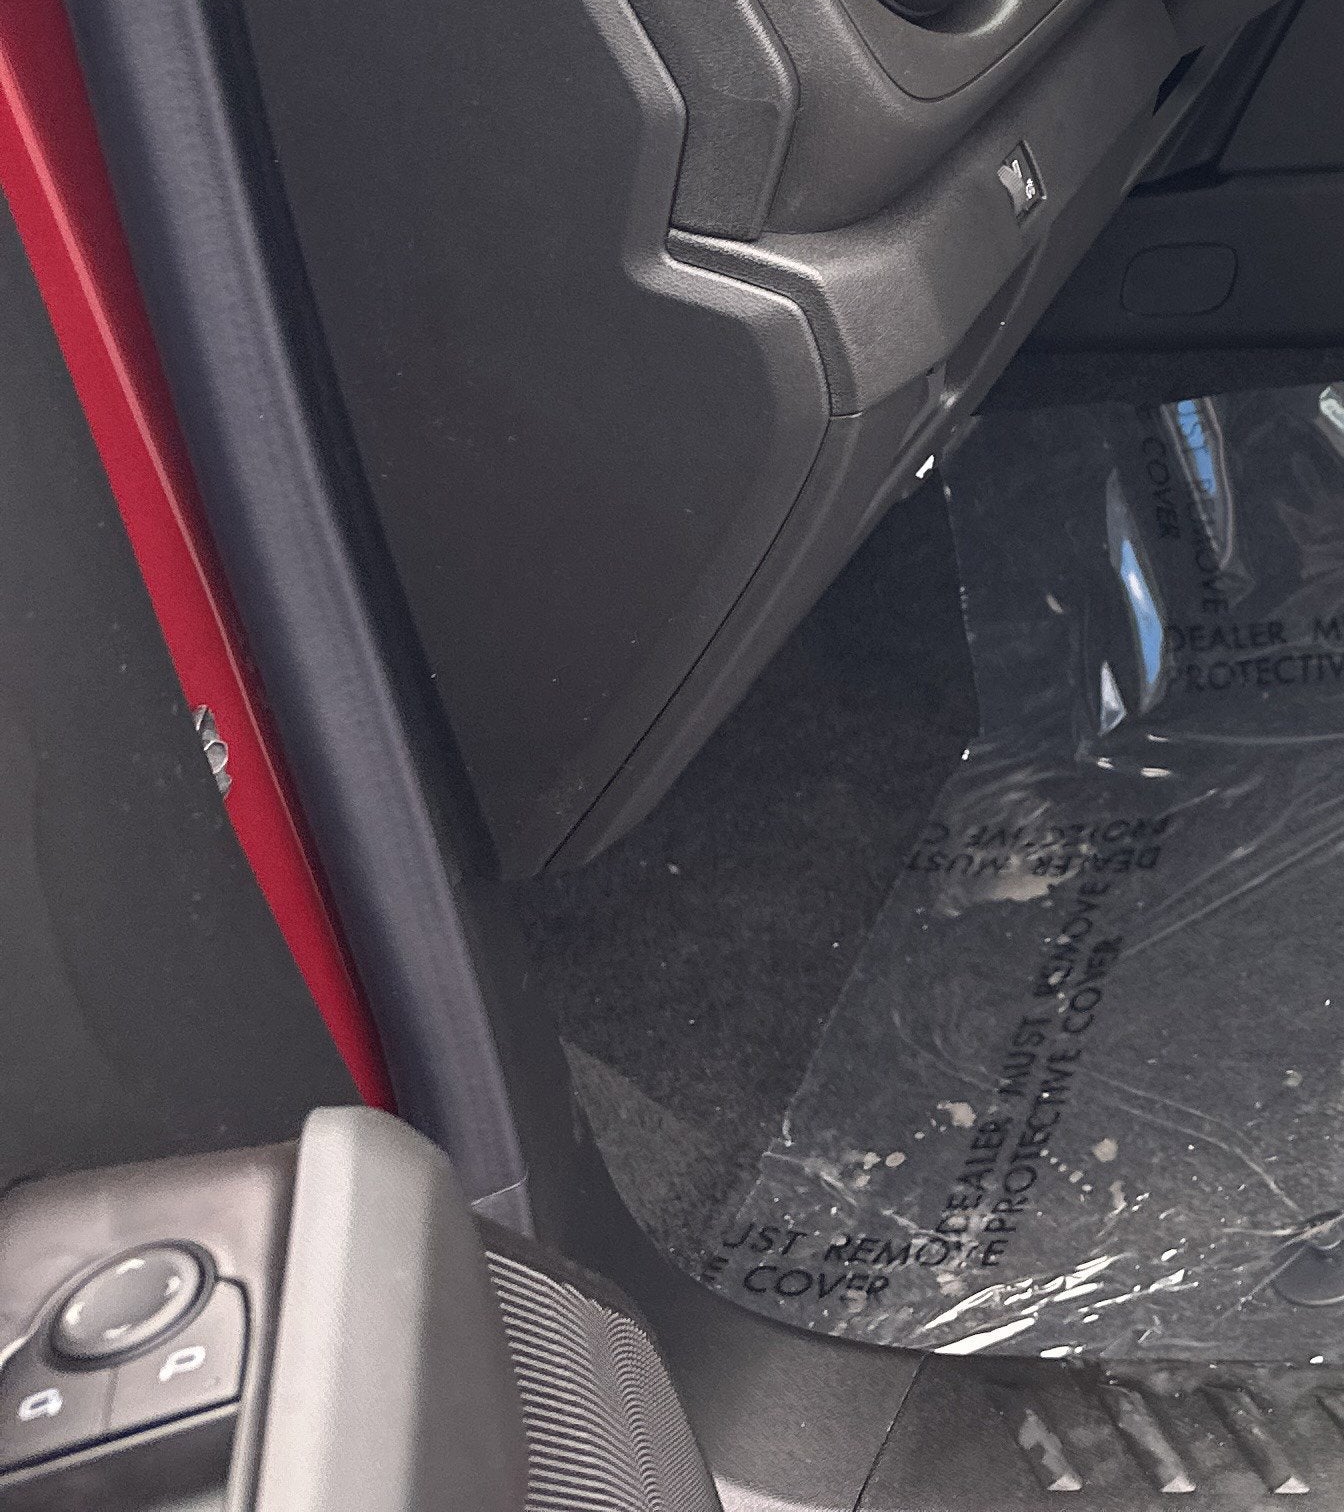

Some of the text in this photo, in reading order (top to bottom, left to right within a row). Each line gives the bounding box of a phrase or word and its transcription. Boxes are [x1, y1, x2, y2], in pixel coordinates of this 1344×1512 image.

[1166, 624, 1287, 656] DEALER
[935, 1115, 1011, 1235] DEALER
[996, 1014, 1052, 1100] MUST
[985, 1046, 1083, 1234] PROTECTIVE
[743, 1263, 890, 1306] COVER
